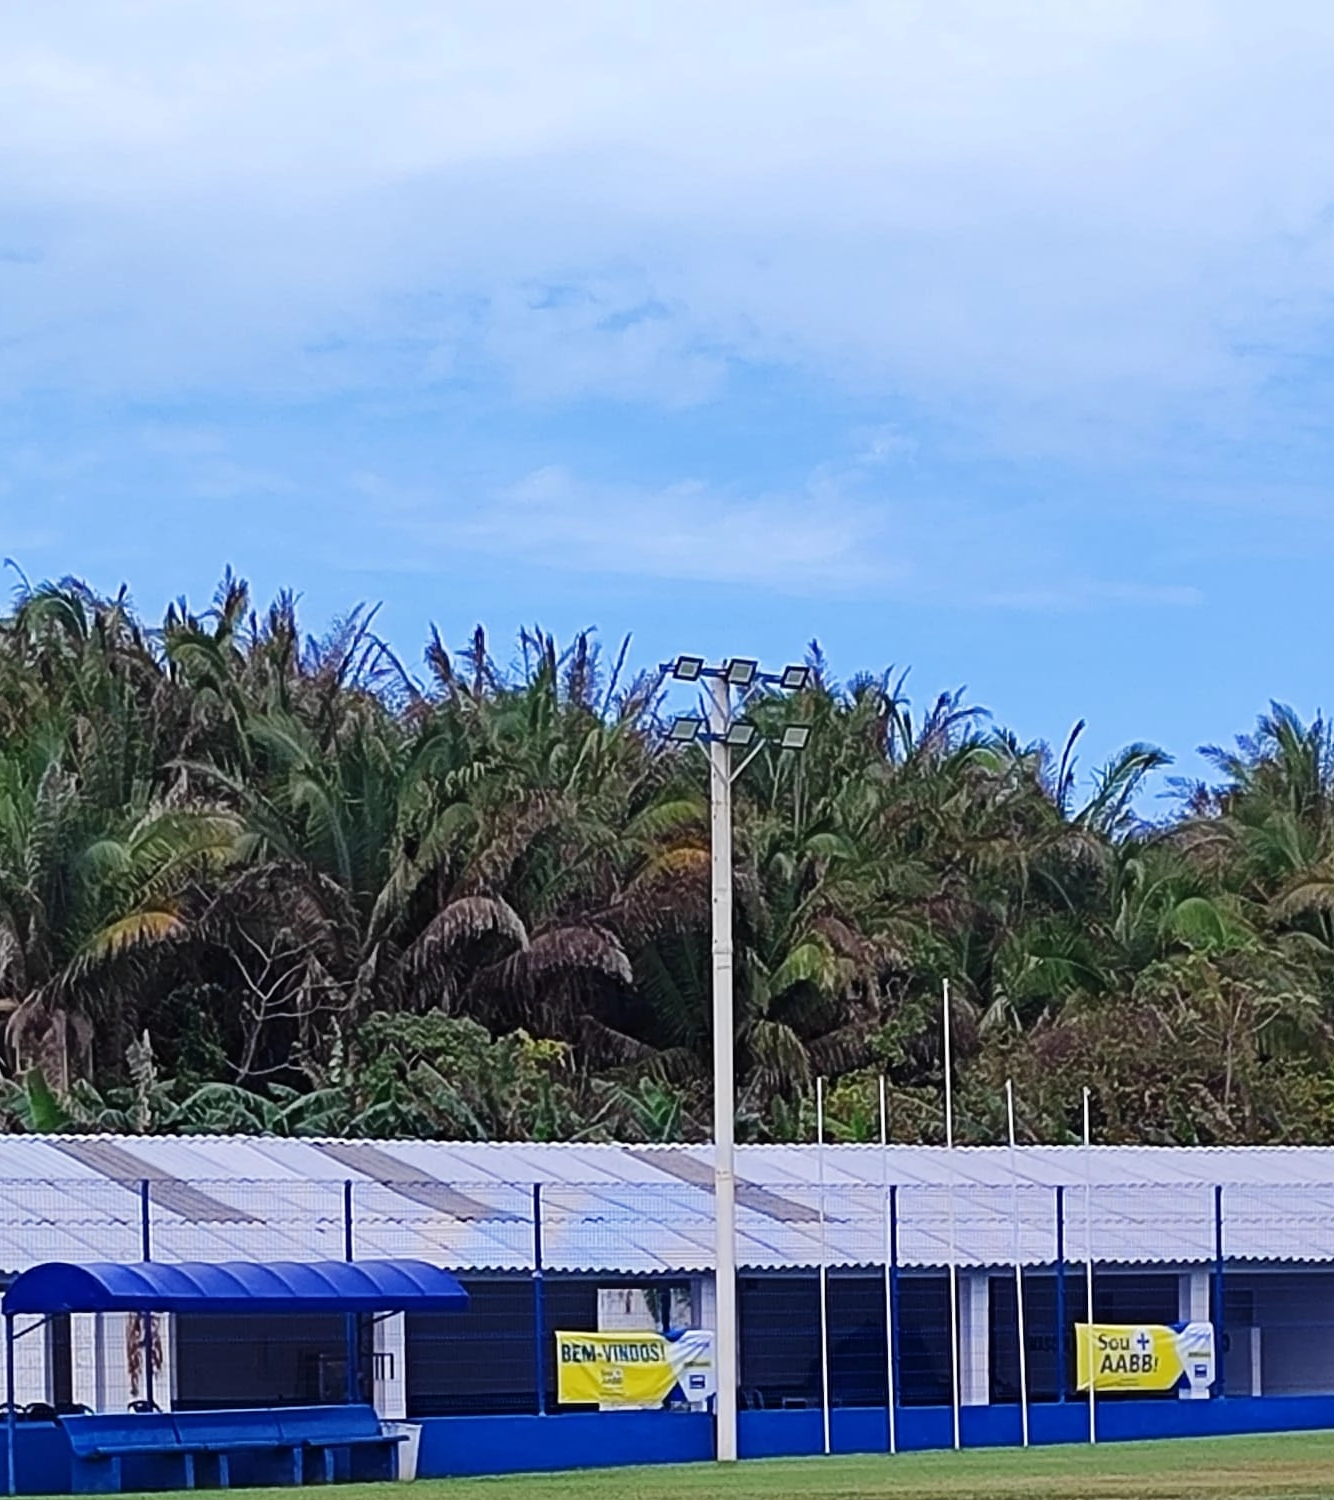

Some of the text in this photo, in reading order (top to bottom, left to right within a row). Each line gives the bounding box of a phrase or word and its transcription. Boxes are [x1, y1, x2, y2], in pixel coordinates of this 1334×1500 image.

[1098, 1333, 1130, 1351] Sou
[561, 1342, 666, 1363] BEM-VINDOS!
[1100, 1354, 1158, 1374] AABB!
